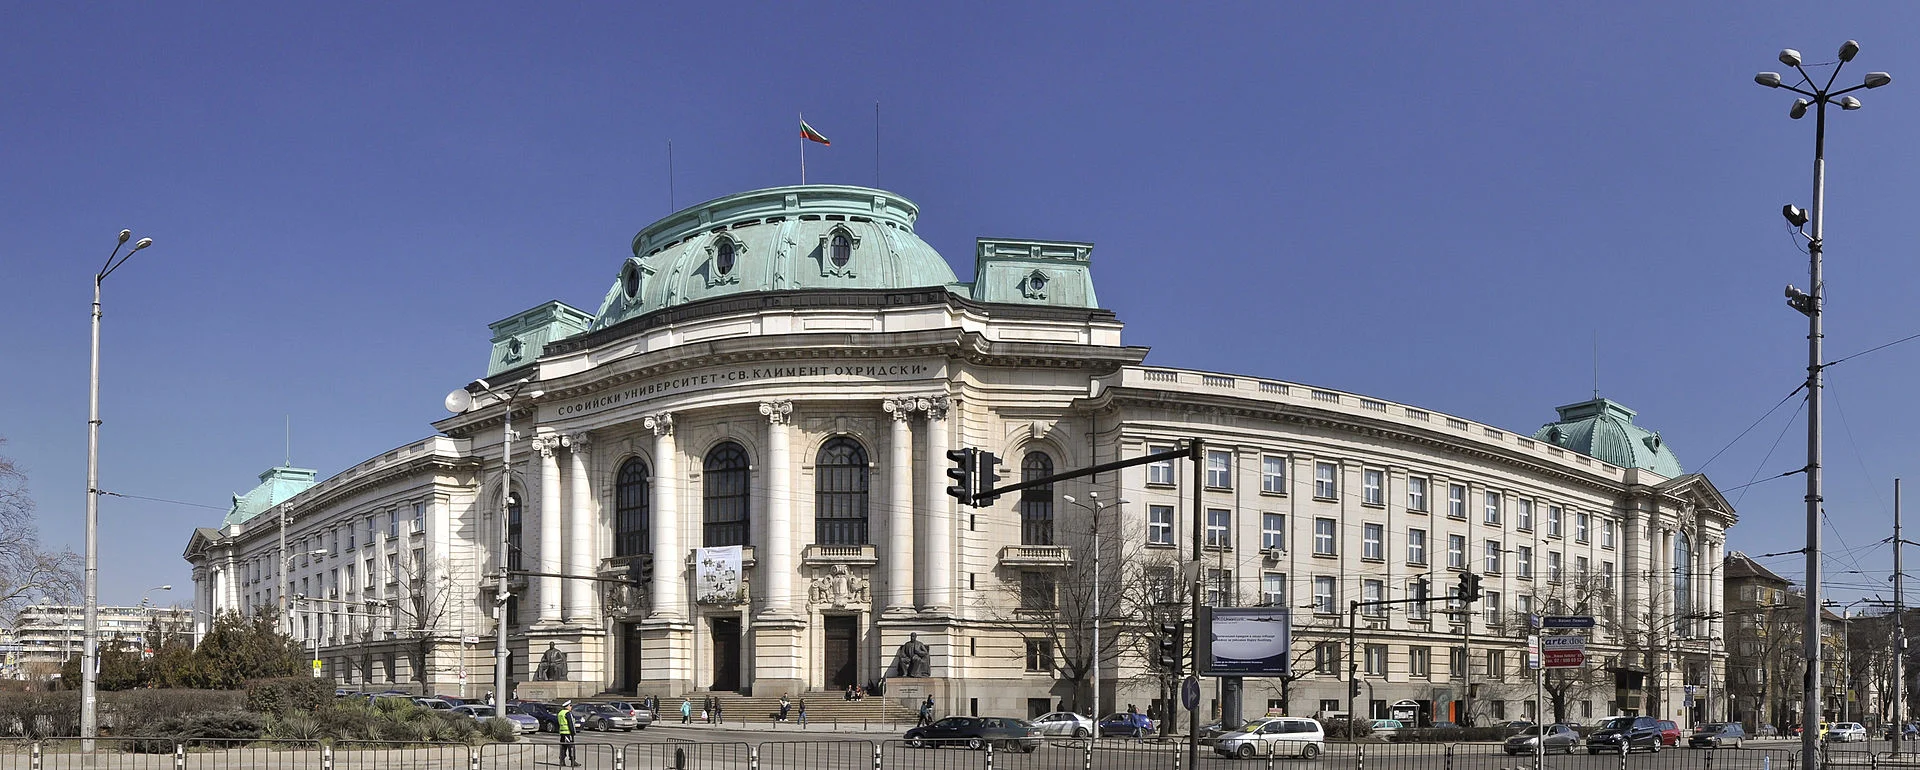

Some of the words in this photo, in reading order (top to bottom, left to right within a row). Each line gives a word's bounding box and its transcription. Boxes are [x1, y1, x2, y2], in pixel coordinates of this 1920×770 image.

[624, 374, 718, 400] УНИВЕРСИТЕТ
[753, 366, 829, 379] КЛИМЕНТ
[834, 365, 921, 376] ОХРИДСКИ
